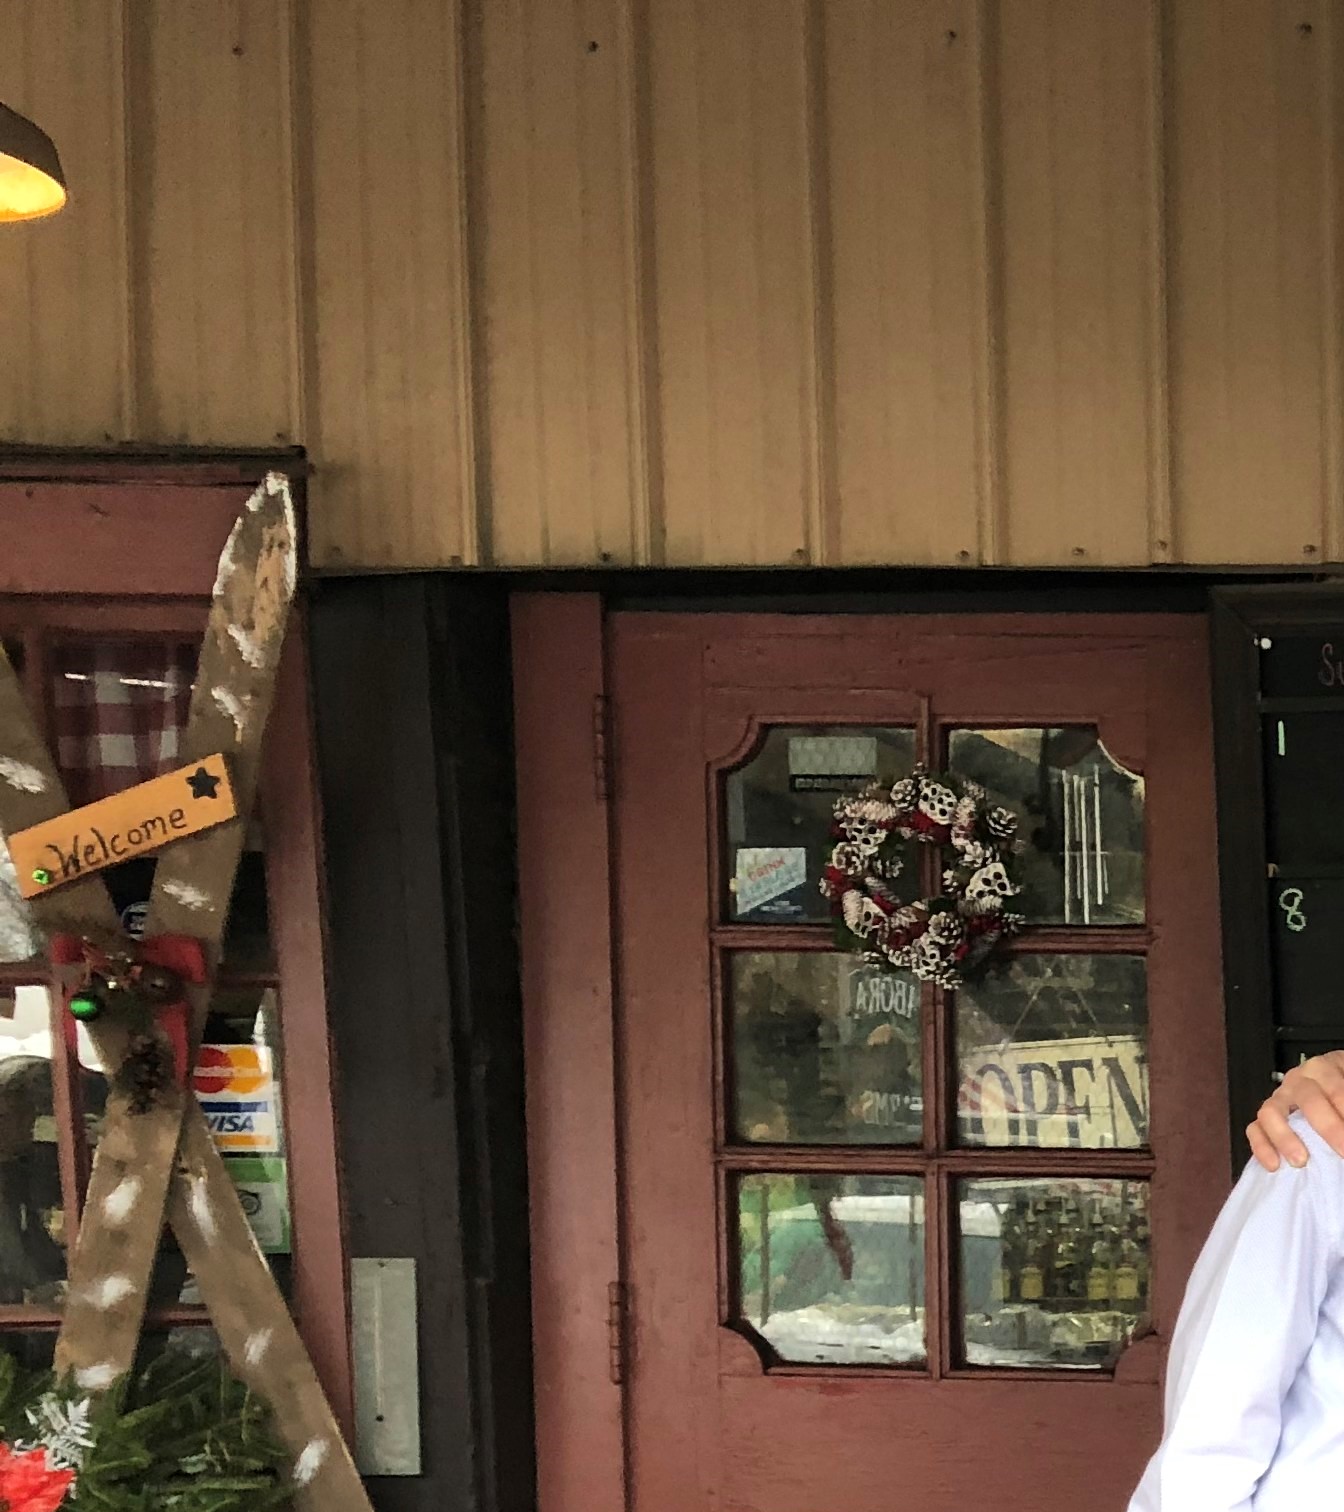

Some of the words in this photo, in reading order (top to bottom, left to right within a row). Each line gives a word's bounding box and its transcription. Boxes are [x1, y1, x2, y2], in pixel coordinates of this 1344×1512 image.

[1276, 720, 1286, 756] 1
[45, 806, 188, 878] Welcome
[1278, 887, 1307, 932] 8
[208, 1114, 255, 1133] VISA
